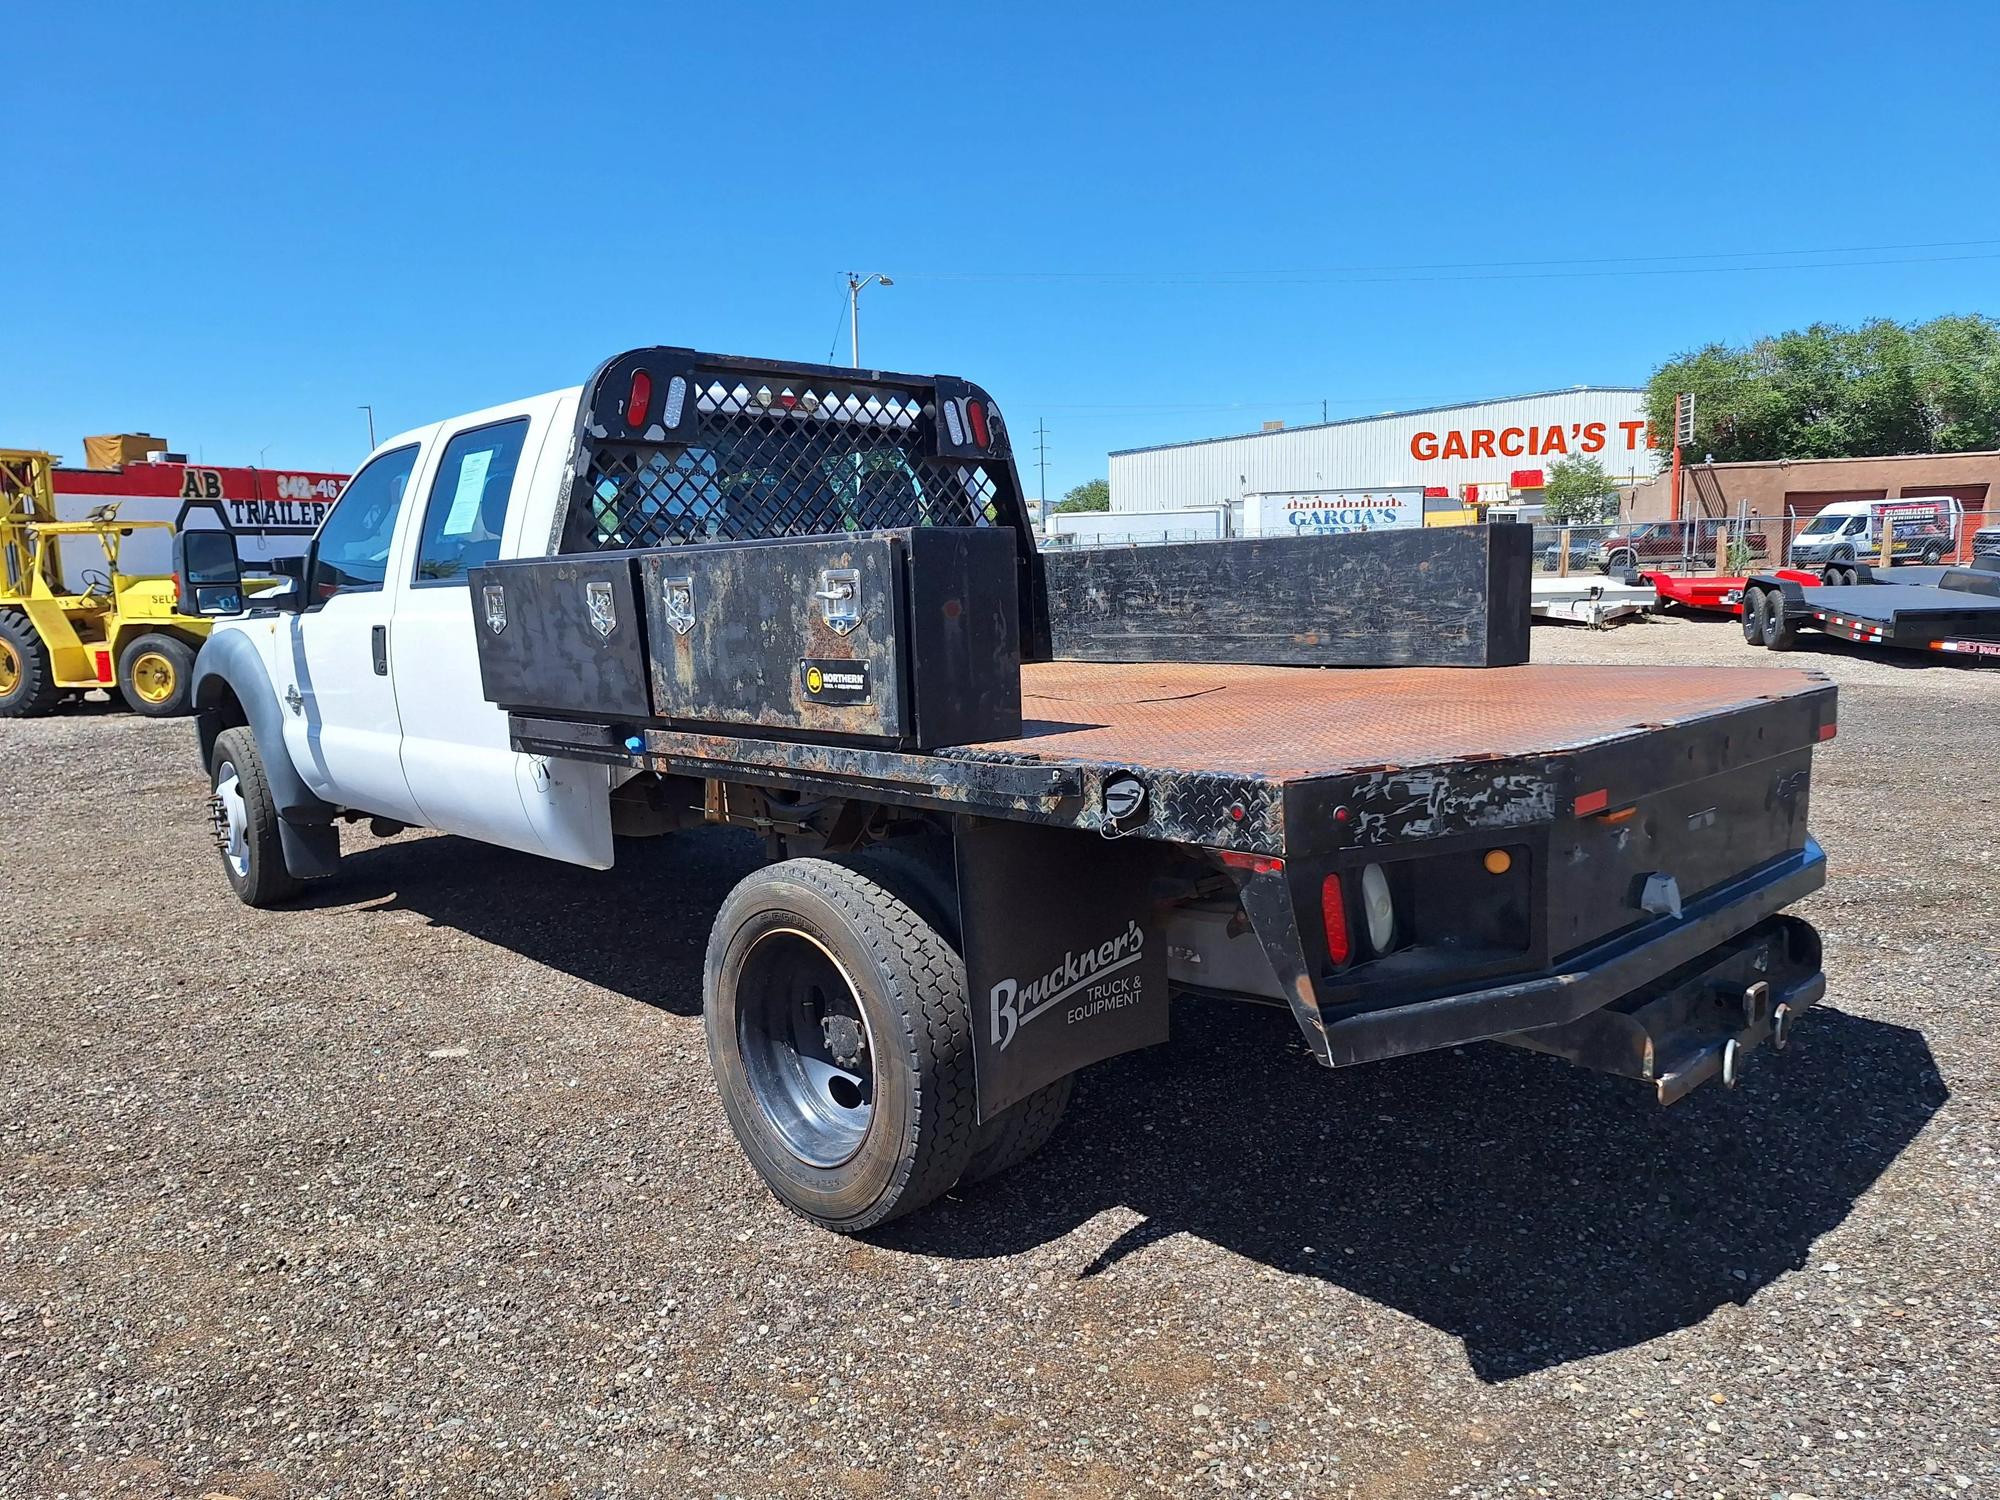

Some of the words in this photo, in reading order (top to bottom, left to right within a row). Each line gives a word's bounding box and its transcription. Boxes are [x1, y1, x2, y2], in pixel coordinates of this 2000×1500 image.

[1411, 422, 1606, 461] GARCIA'S
[181, 470, 223, 498] AB
[277, 475, 348, 498] 342-46
[230, 500, 332, 525] TRAILER
[1288, 508, 1397, 526] GARCIA'S
[823, 673, 864, 683] NORTHERN
[990, 920, 1144, 1052] Bruckner's
[1087, 978, 1130, 1001] TRUCK
[1133, 976, 1142, 989] &
[1067, 990, 1142, 1024] EQUIPMENT
